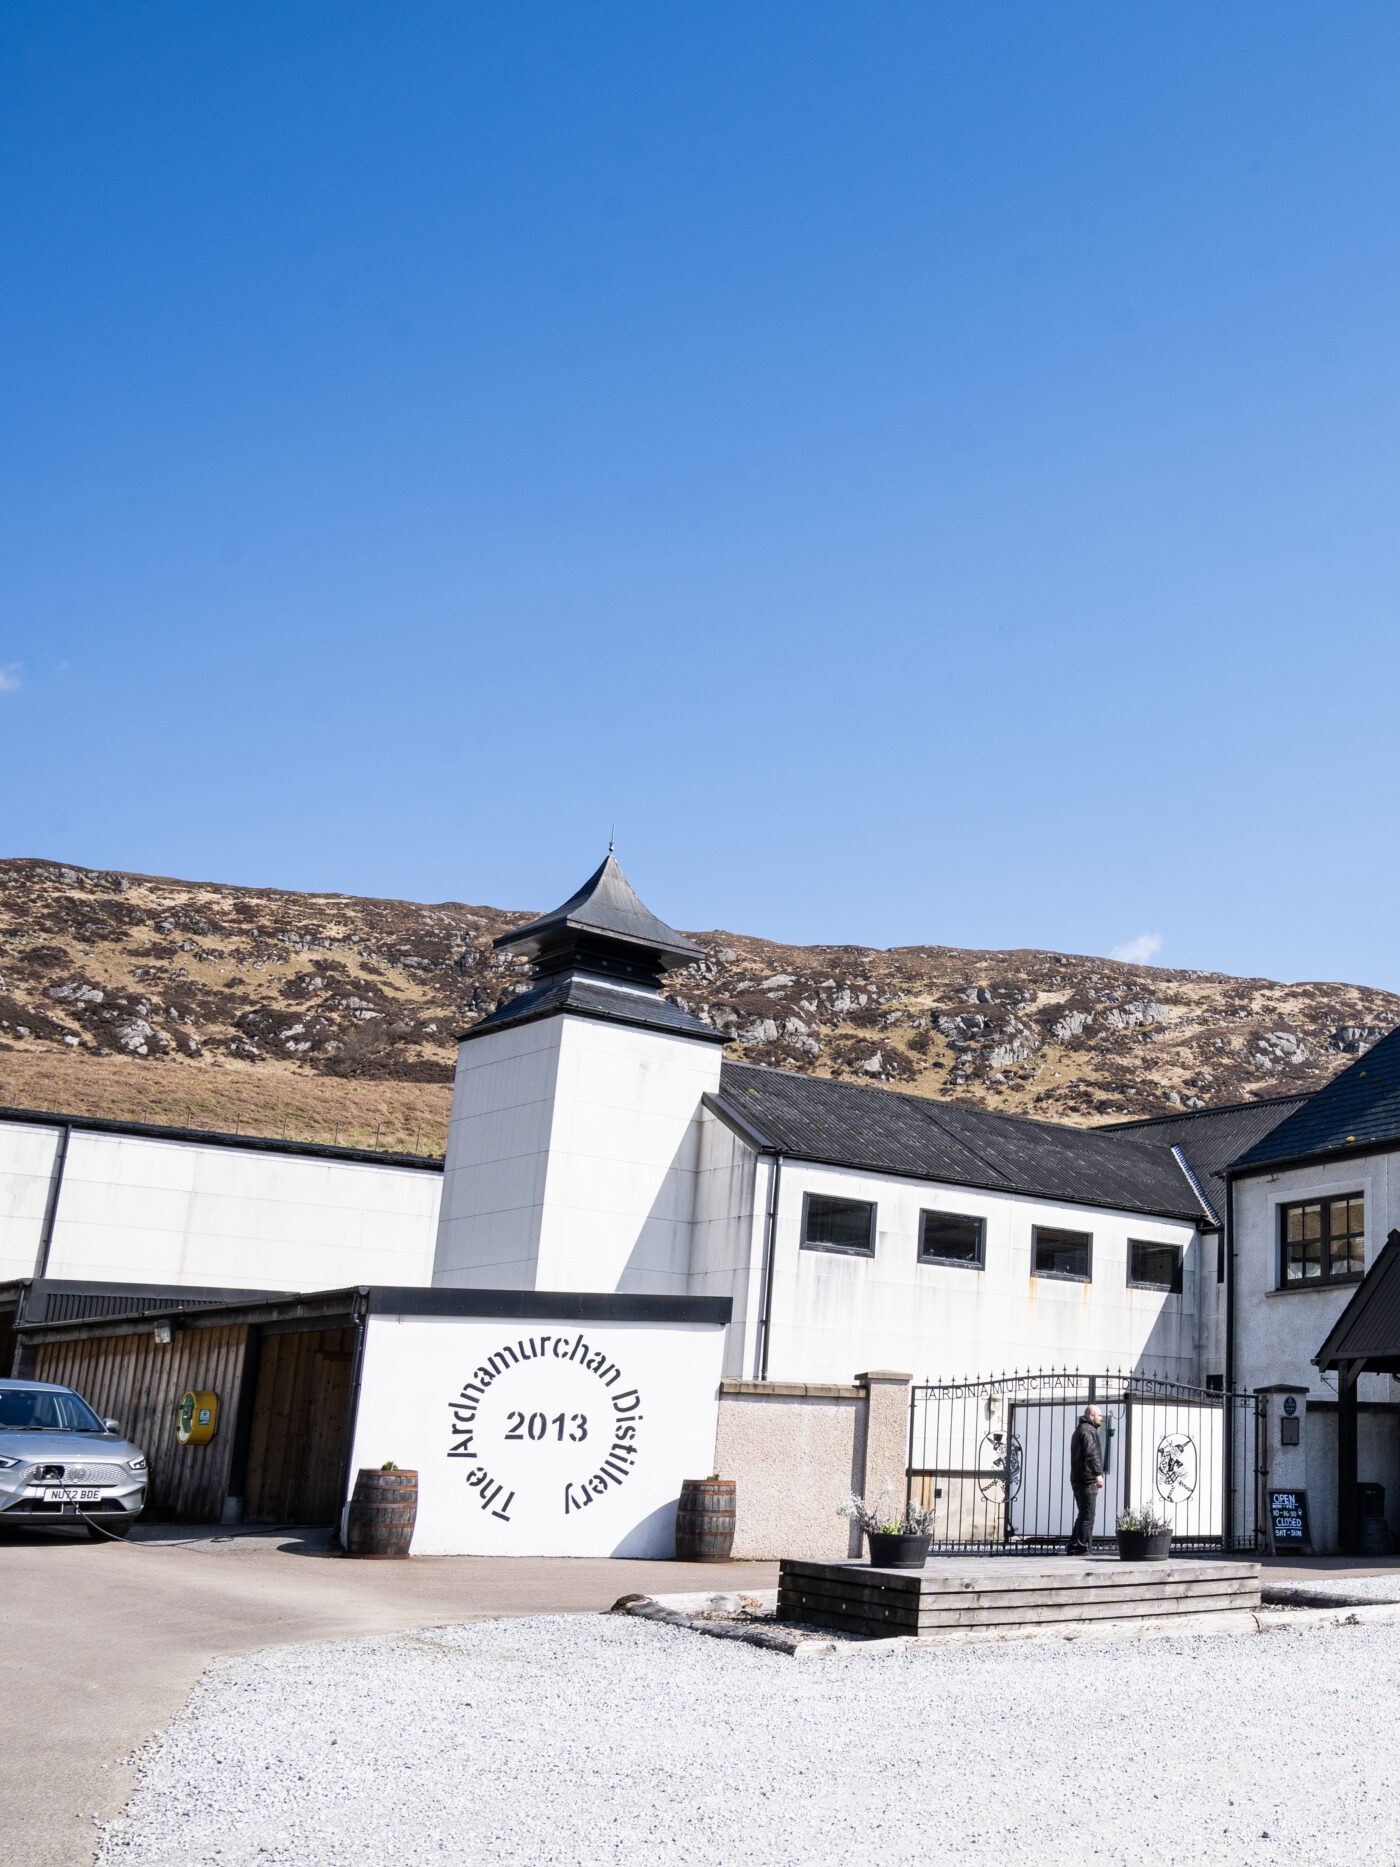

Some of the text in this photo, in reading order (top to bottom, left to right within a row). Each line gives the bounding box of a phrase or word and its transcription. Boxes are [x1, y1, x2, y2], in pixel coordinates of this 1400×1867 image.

[928, 1376, 1075, 1400] ARDNAMURCHAN
[446, 1334, 644, 1522] The Ardnamurchan Distillery
[504, 1411, 588, 1442] 2013
[80, 1490, 100, 1499] BDE
[1273, 1494, 1296, 1504] OPEN
[1276, 1518, 1302, 1527] CLOSED
